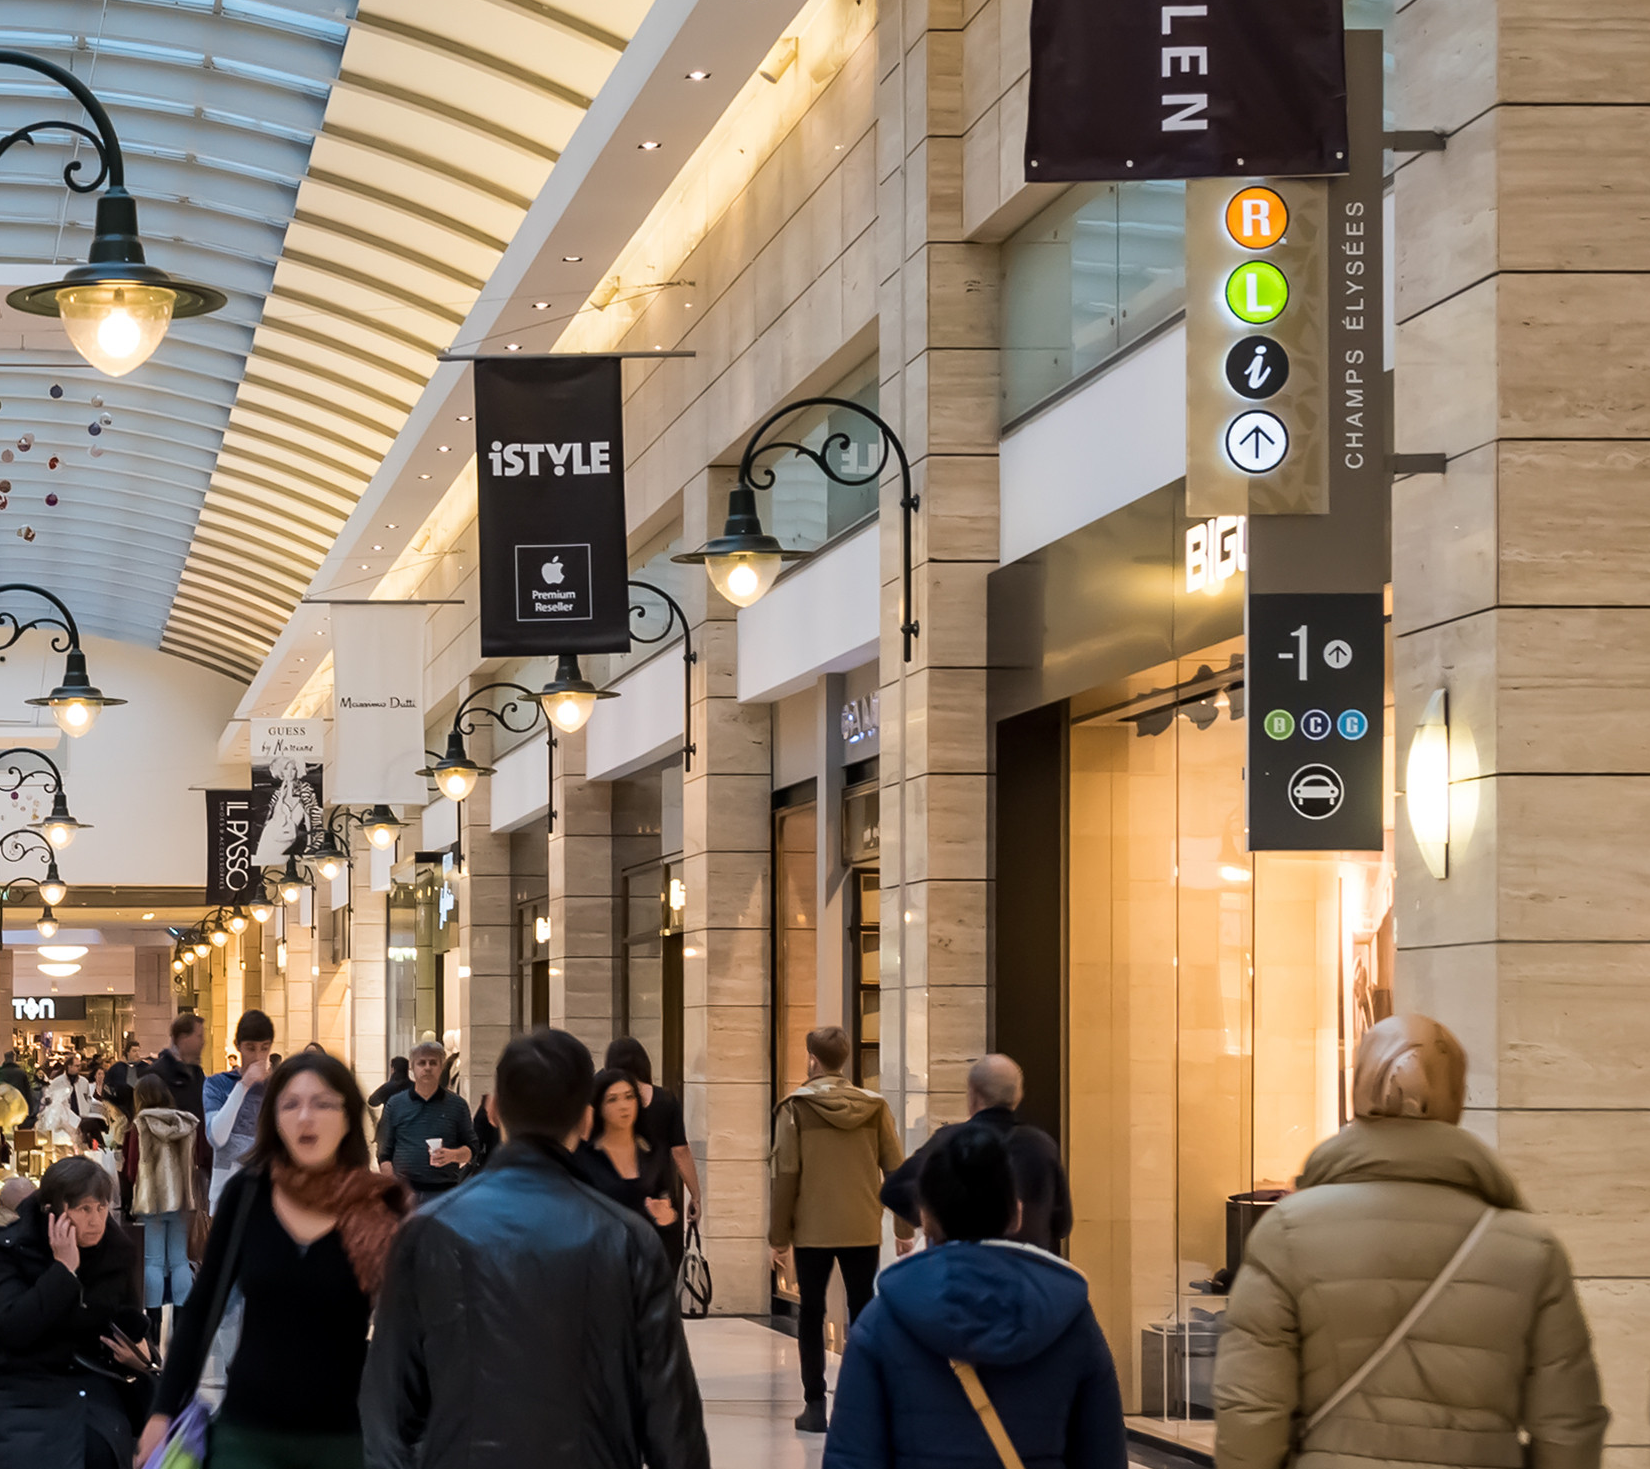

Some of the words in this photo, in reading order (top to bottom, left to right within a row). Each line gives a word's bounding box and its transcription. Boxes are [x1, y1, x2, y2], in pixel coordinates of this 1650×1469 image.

[1242, 198, 1272, 238] R
[1341, 199, 1364, 329] ÉLYSÉES
[1246, 272, 1273, 314] L
[1345, 348, 1364, 469] CHAMPS
[488, 440, 611, 477] iSTYLE
[532, 589, 576, 602] Premium
[534, 601, 574, 613] Reseller
[340, 696, 387, 709] Massimo
[389, 696, 417, 709] Dutti
[268, 727, 306, 736] GUESS
[226, 801, 249, 816] IL
[225, 820, 249, 891] PASSO
